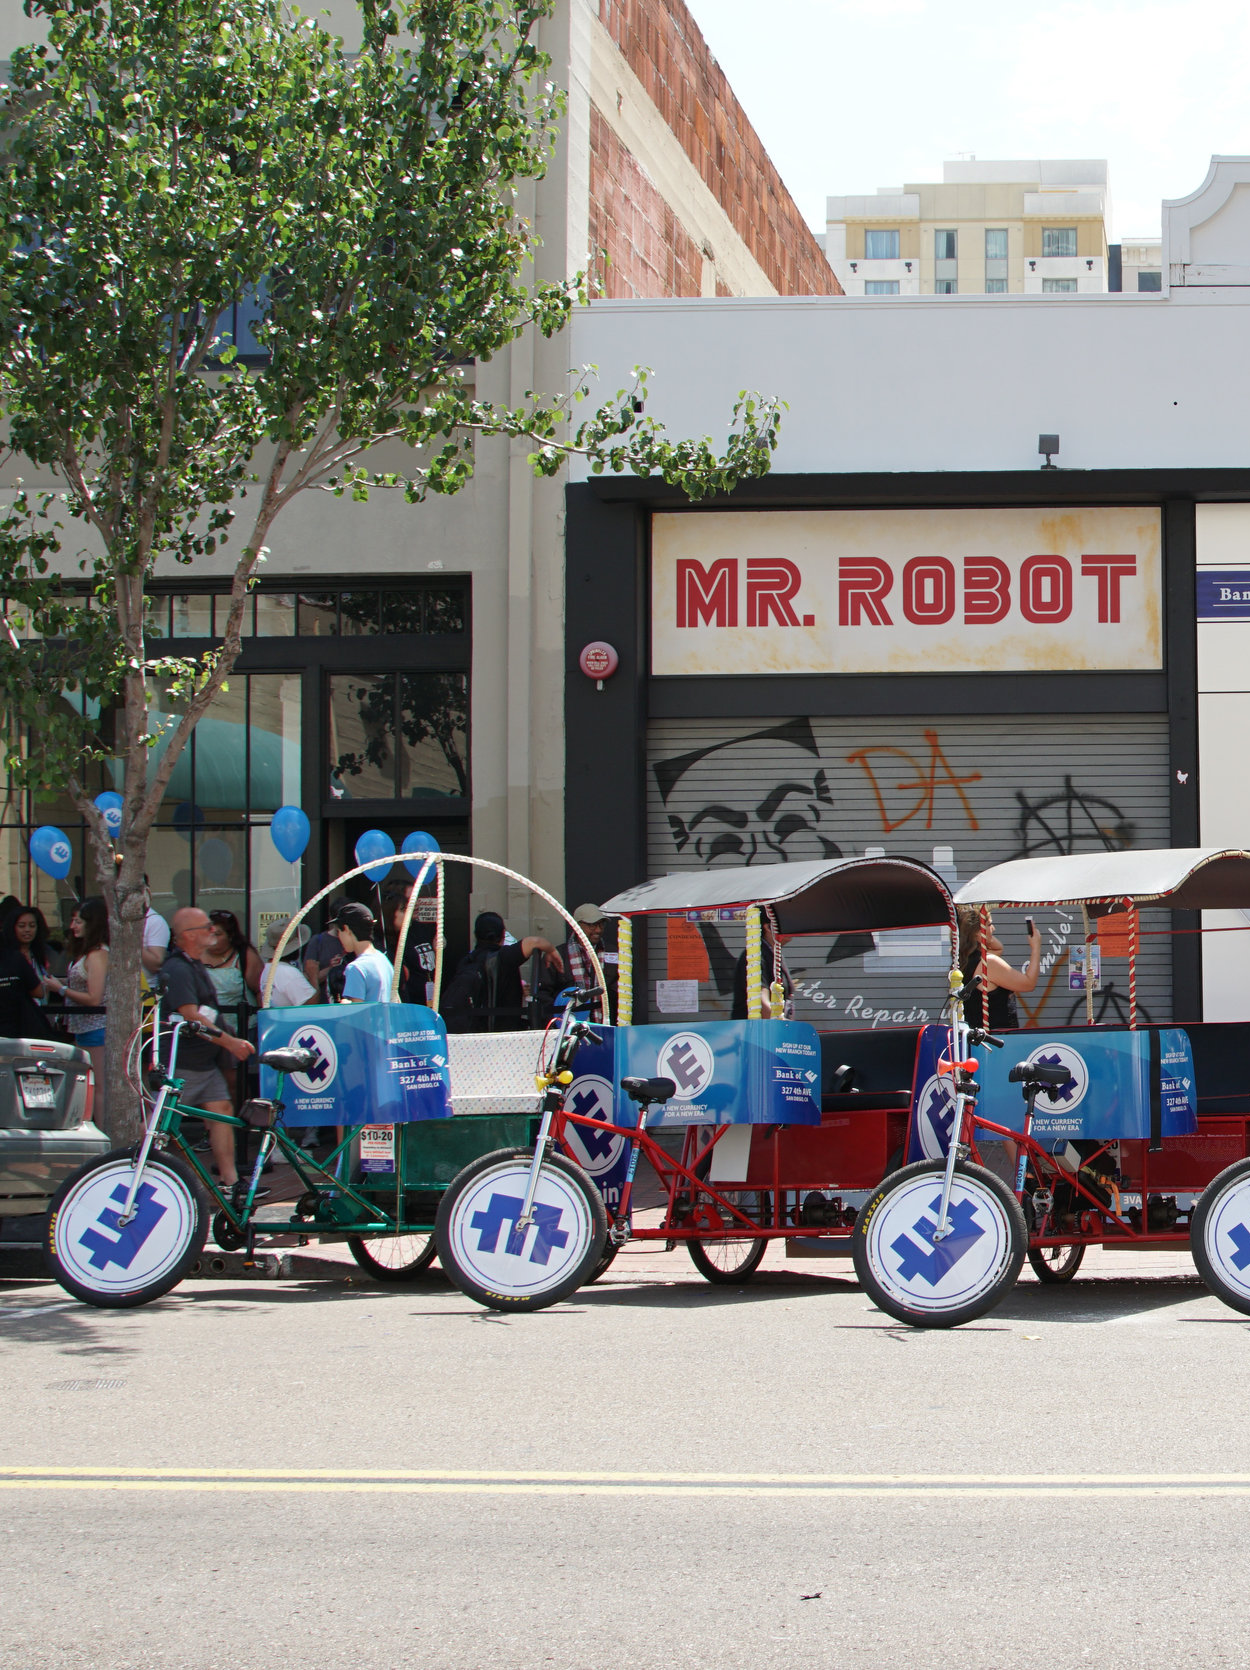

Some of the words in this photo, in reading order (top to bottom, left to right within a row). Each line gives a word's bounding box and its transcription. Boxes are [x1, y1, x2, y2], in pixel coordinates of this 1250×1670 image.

[675, 557, 815, 628] MR.
[838, 554, 1137, 626] ROBOT
[845, 995, 930, 1028] Repair
[391, 1059, 417, 1070] Bank
[418, 1058, 427, 1066] of
[399, 1075, 415, 1085] 327
[416, 1074, 430, 1082] 4th
[430, 1072, 443, 1081] AVE
[775, 1070, 795, 1079] Bank
[795, 1071, 802, 1080] of
[781, 1086, 793, 1095] 327
[793, 1087, 802, 1095] 4th
[802, 1088, 812, 1096] AVE
[361, 1131, 393, 1141] $10-20
[862, 1192, 884, 1235] MAXXIS
